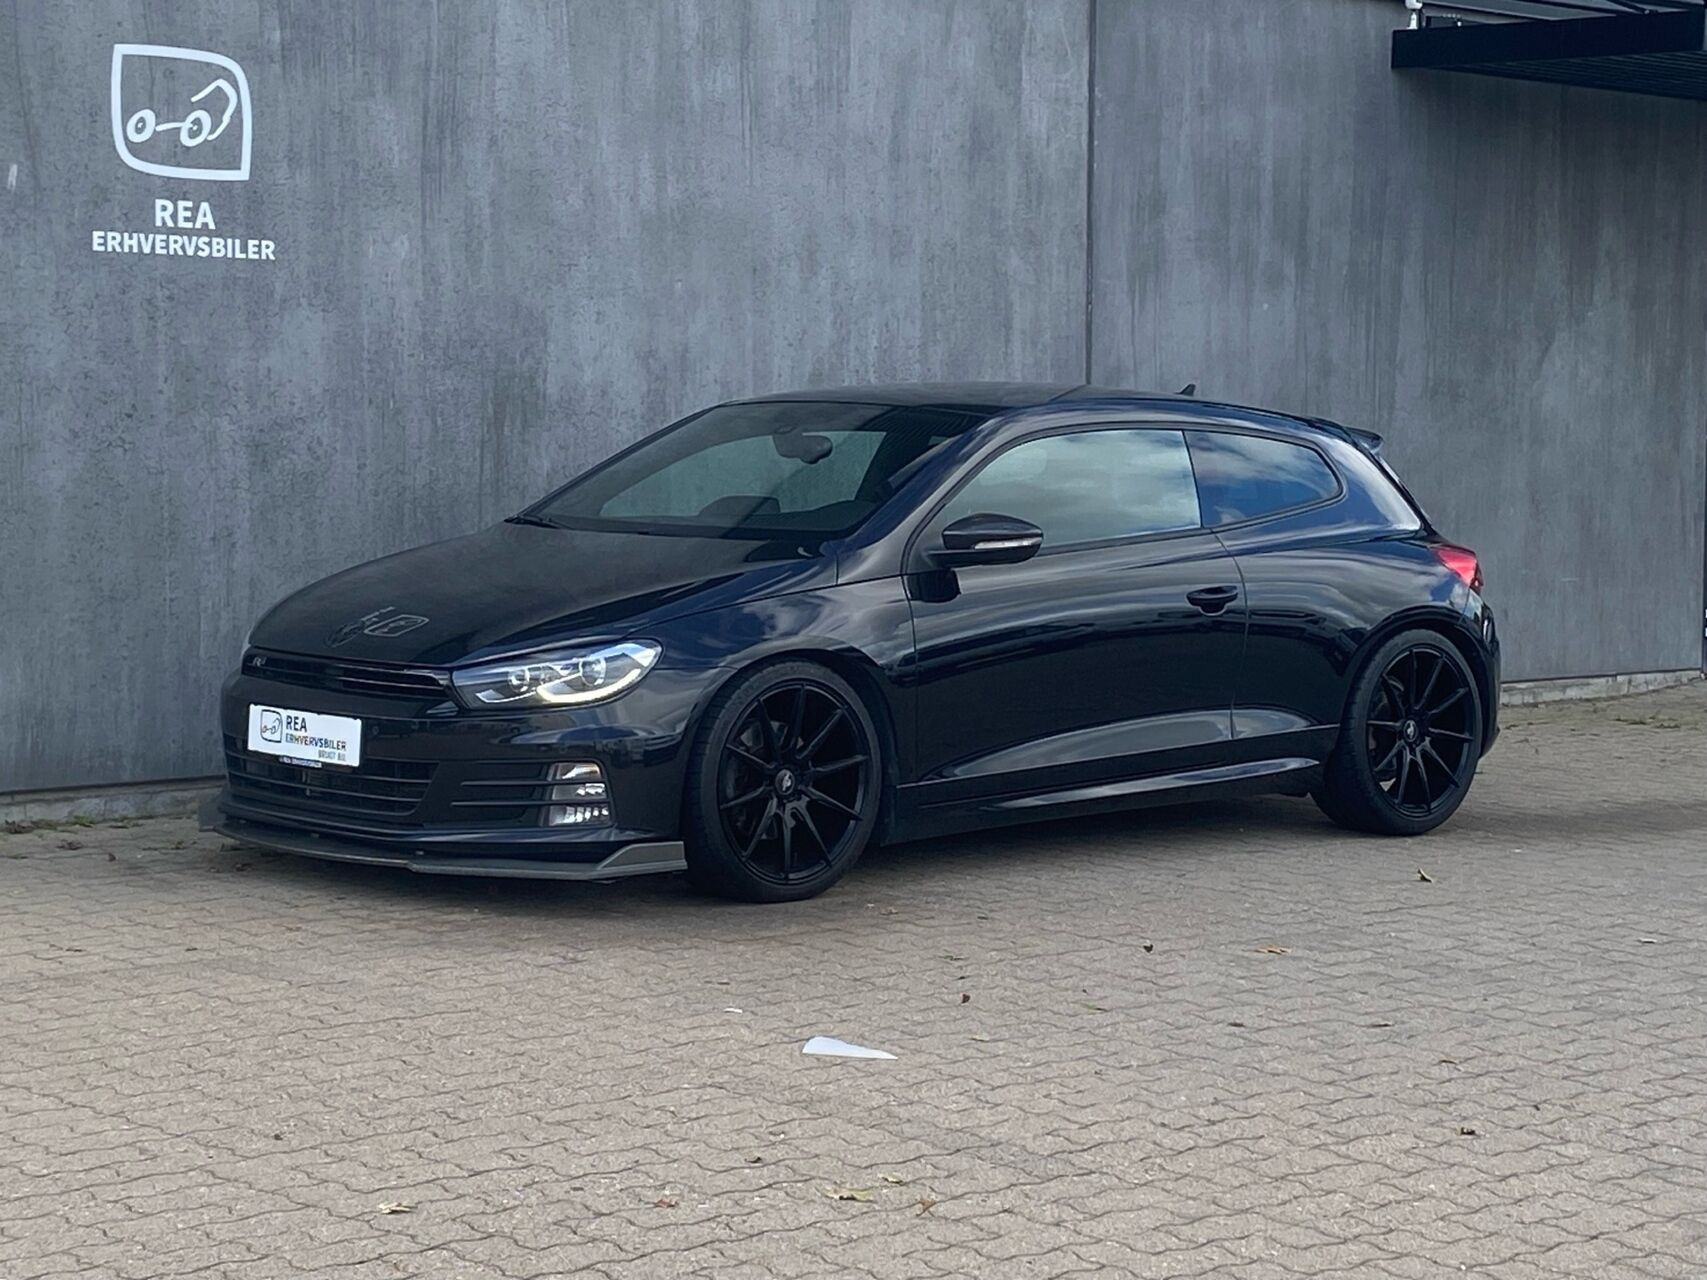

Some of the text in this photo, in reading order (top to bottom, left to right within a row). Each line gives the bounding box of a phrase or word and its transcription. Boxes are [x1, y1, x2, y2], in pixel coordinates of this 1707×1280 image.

[154, 198, 216, 230] REA
[91, 230, 276, 260] ERHVERVSBILER
[285, 715, 308, 733] REA
